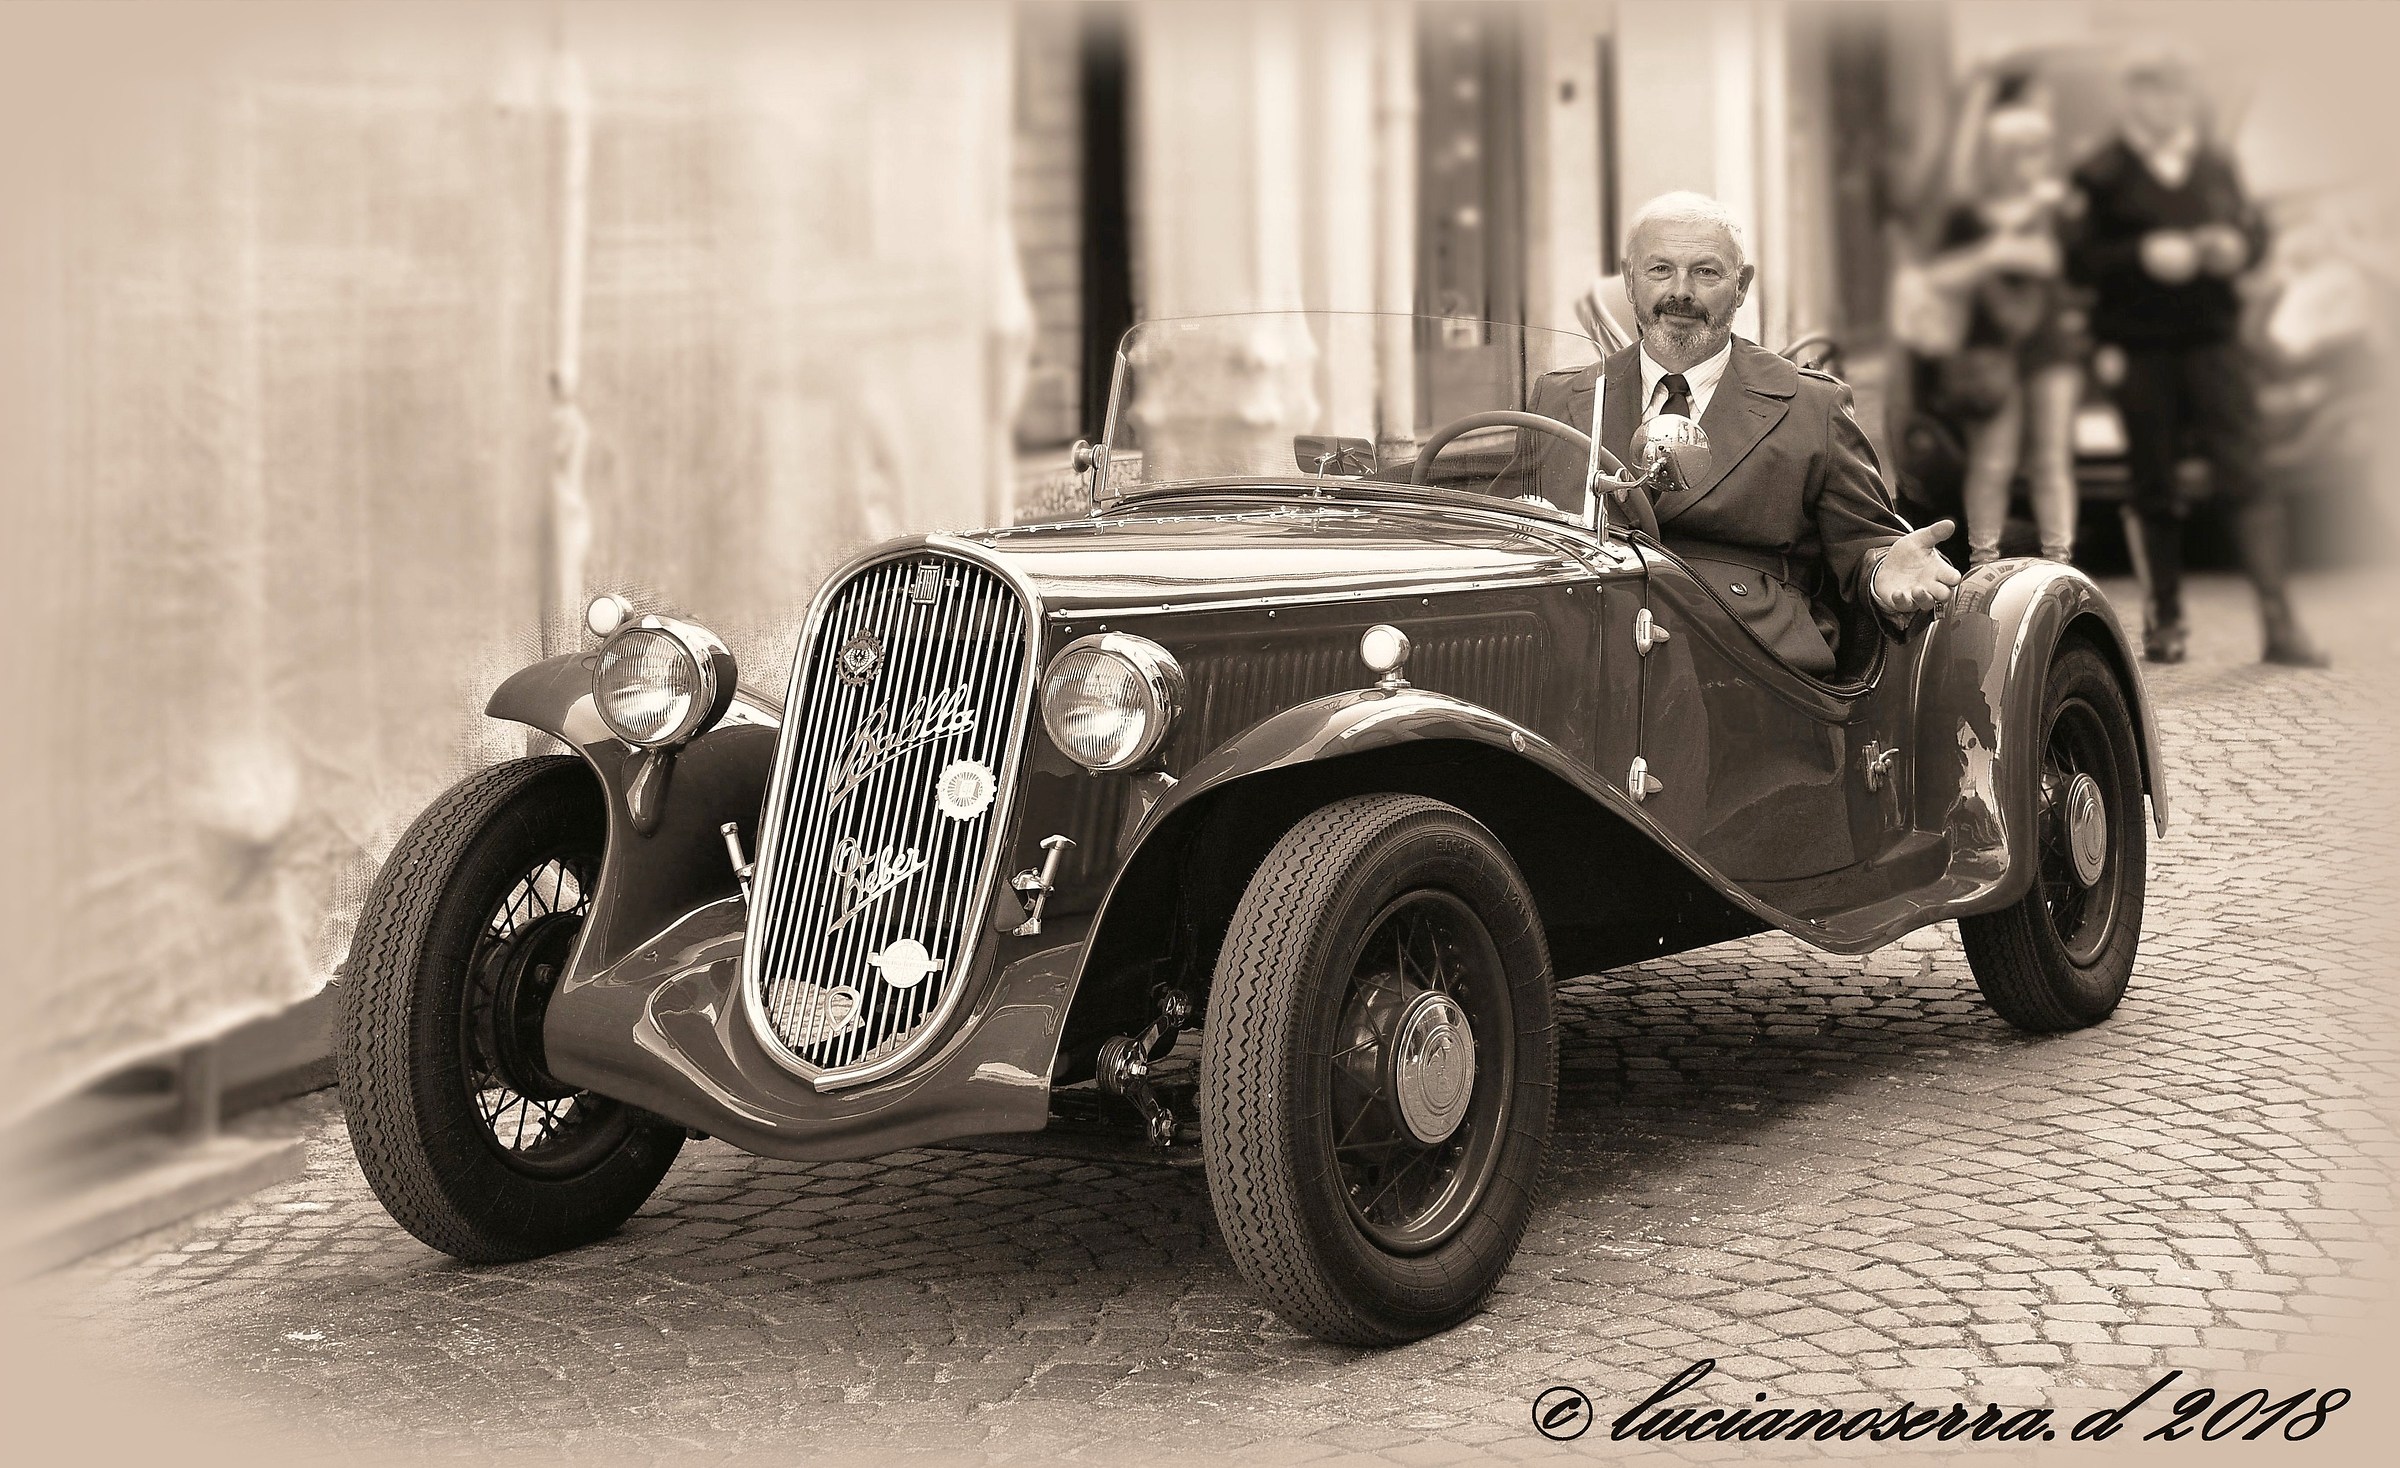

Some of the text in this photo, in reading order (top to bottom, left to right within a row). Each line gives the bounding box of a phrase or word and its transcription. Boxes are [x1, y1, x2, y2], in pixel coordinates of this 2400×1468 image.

[914, 569, 938, 600] FIAT
[829, 683, 976, 810] Balilla
[829, 837, 929, 932] Weber
